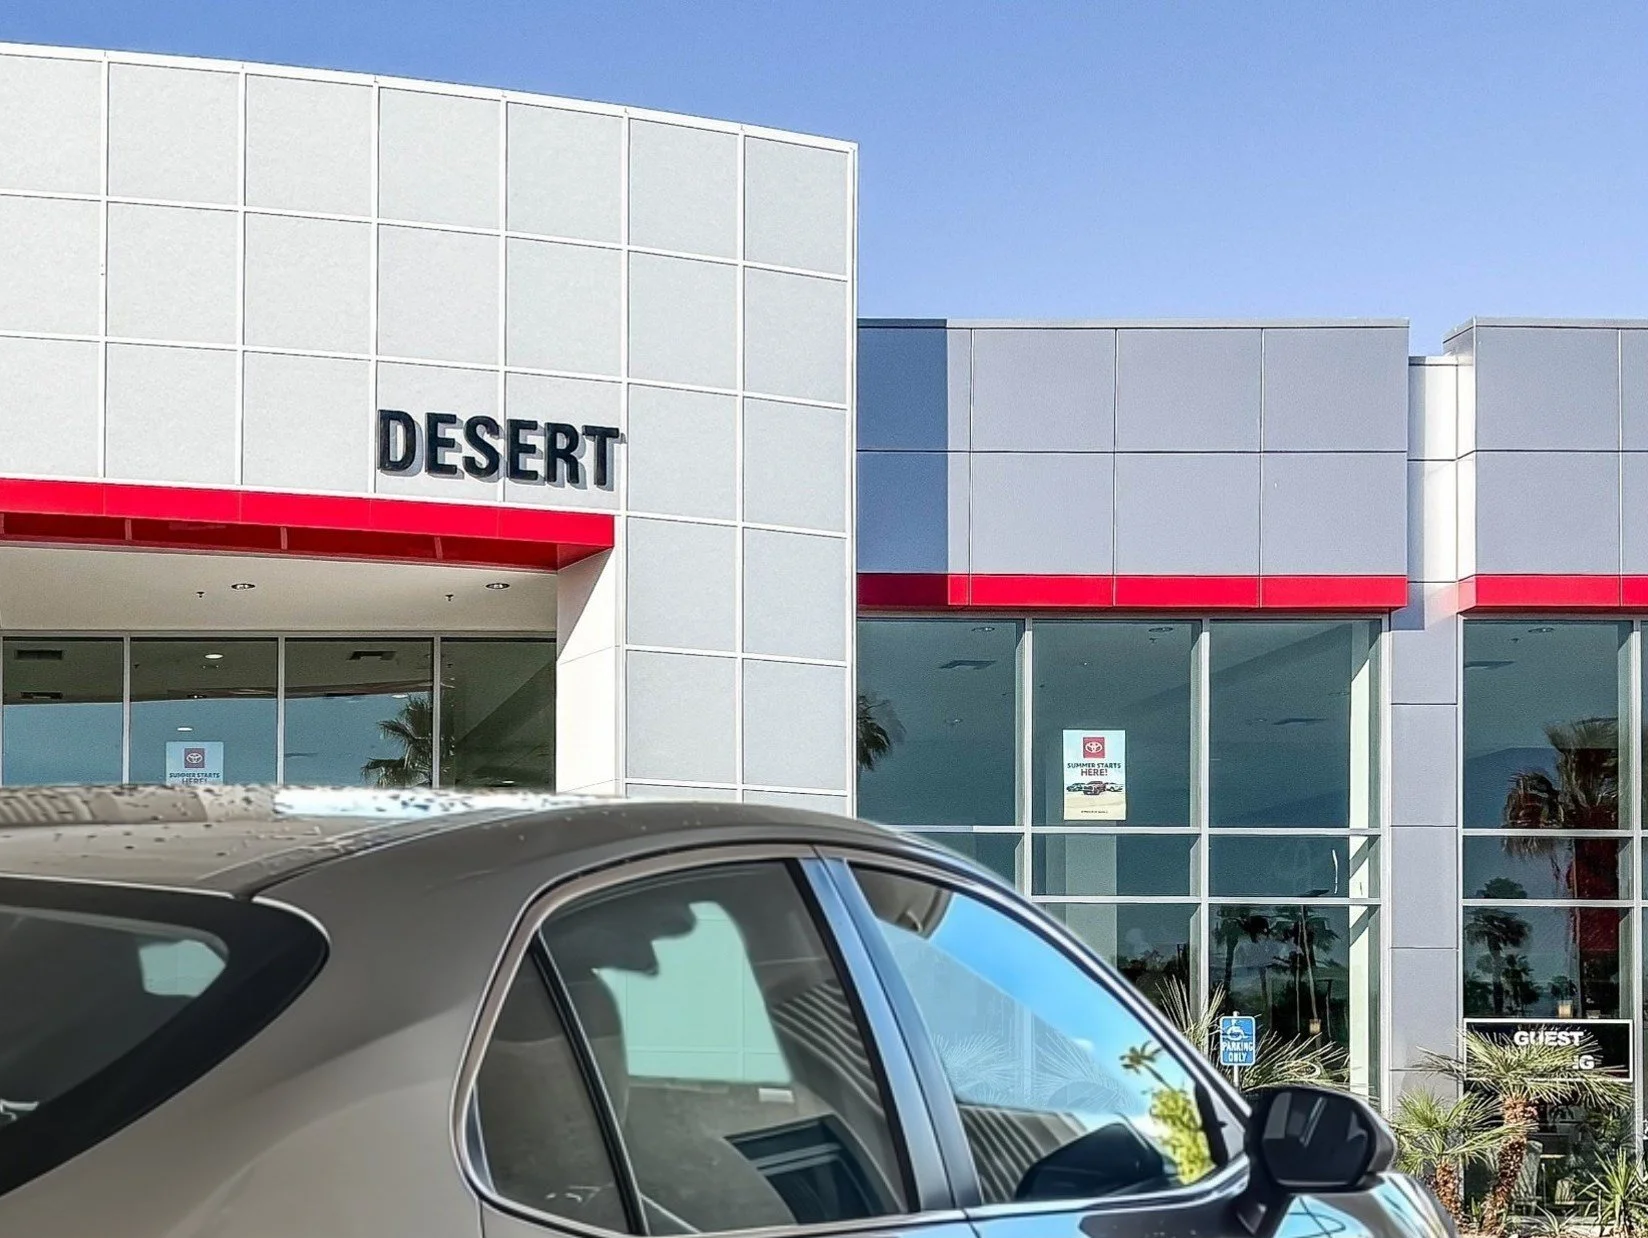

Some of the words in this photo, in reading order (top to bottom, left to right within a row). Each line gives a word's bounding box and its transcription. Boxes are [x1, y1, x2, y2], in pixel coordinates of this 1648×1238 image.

[376, 409, 620, 487] DESERT
[1080, 768, 1108, 777] HERE!
[1513, 1030, 1585, 1047] GUEST
[1222, 1040, 1254, 1052] PARKING
[1228, 1051, 1248, 1062] ONLY
